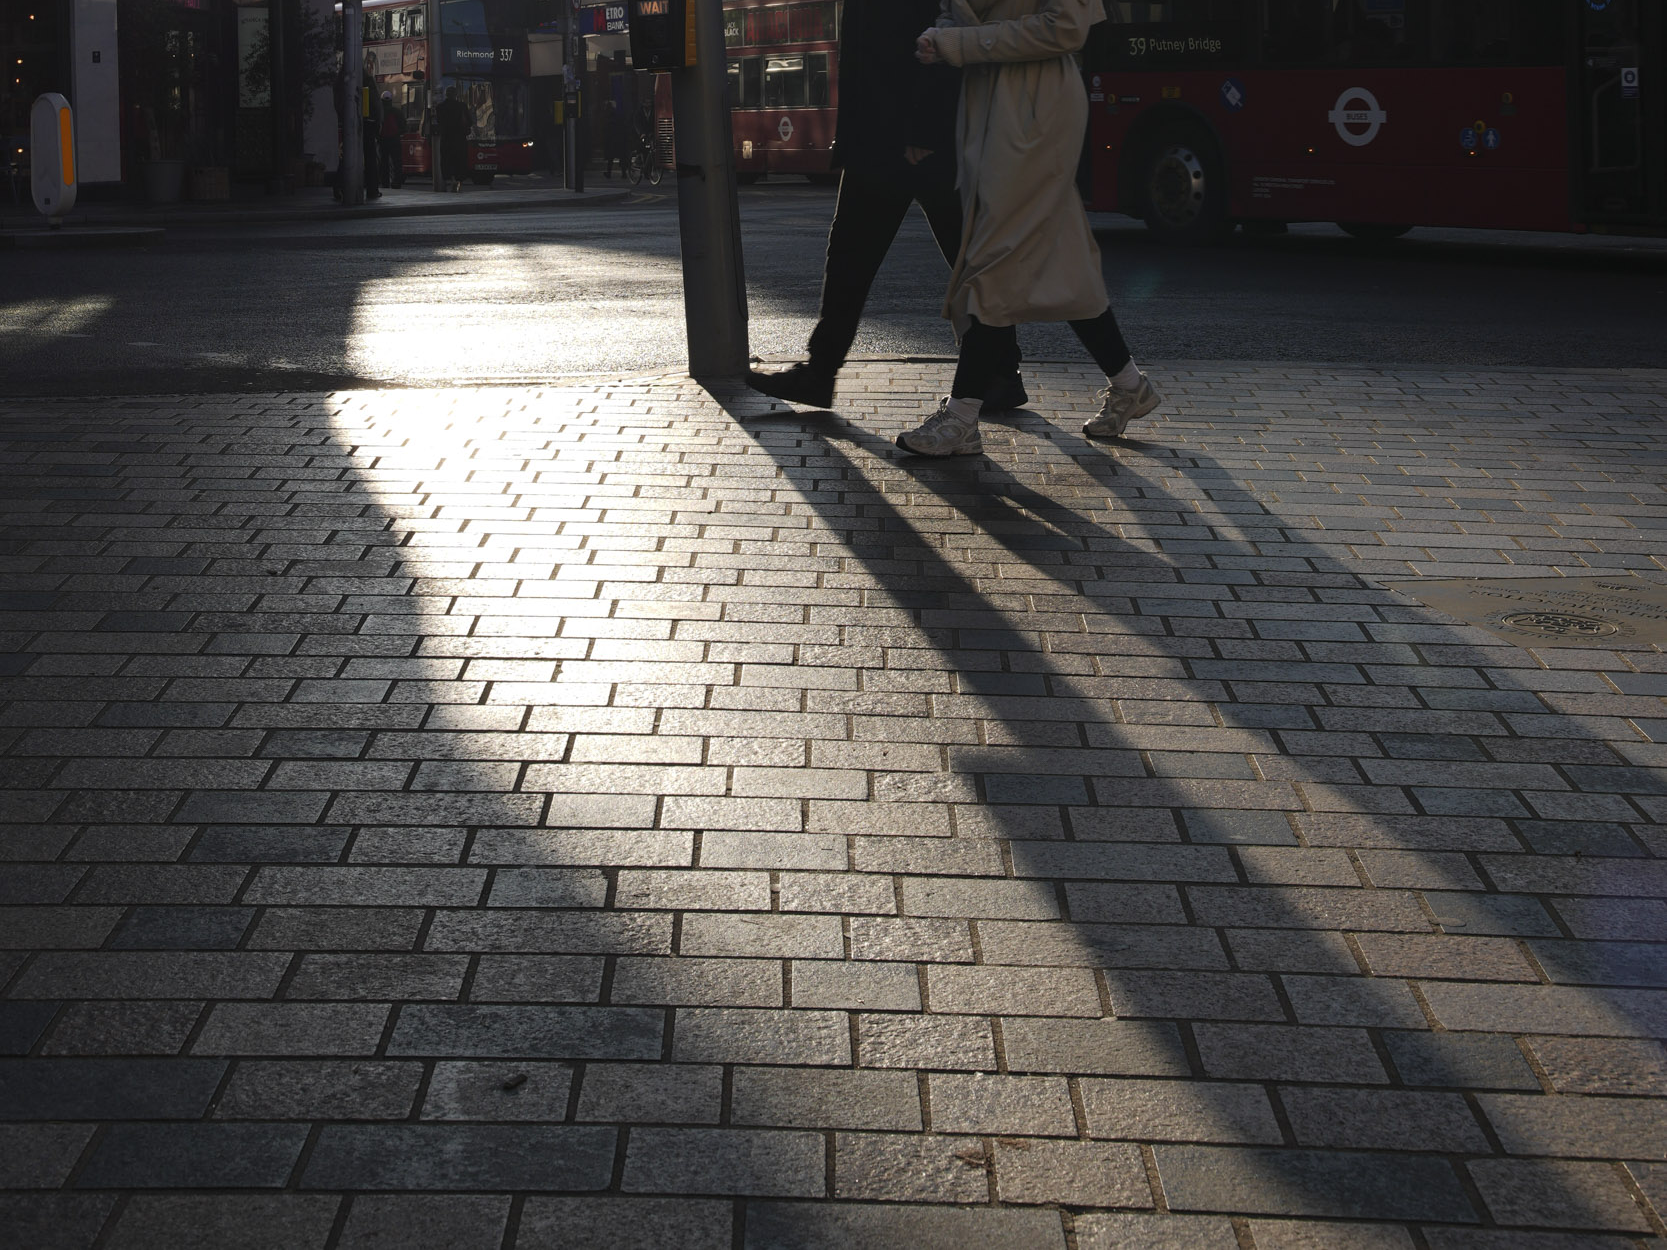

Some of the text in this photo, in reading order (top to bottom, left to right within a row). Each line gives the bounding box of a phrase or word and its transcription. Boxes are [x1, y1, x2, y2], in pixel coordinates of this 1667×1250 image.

[640, 0, 669, 14] WAIT
[607, 21, 625, 31] BANK
[724, 28, 739, 37] BLACK
[1128, 38, 1222, 55] 39 Putney Bridge
[456, 49, 513, 62] Richmond 337
